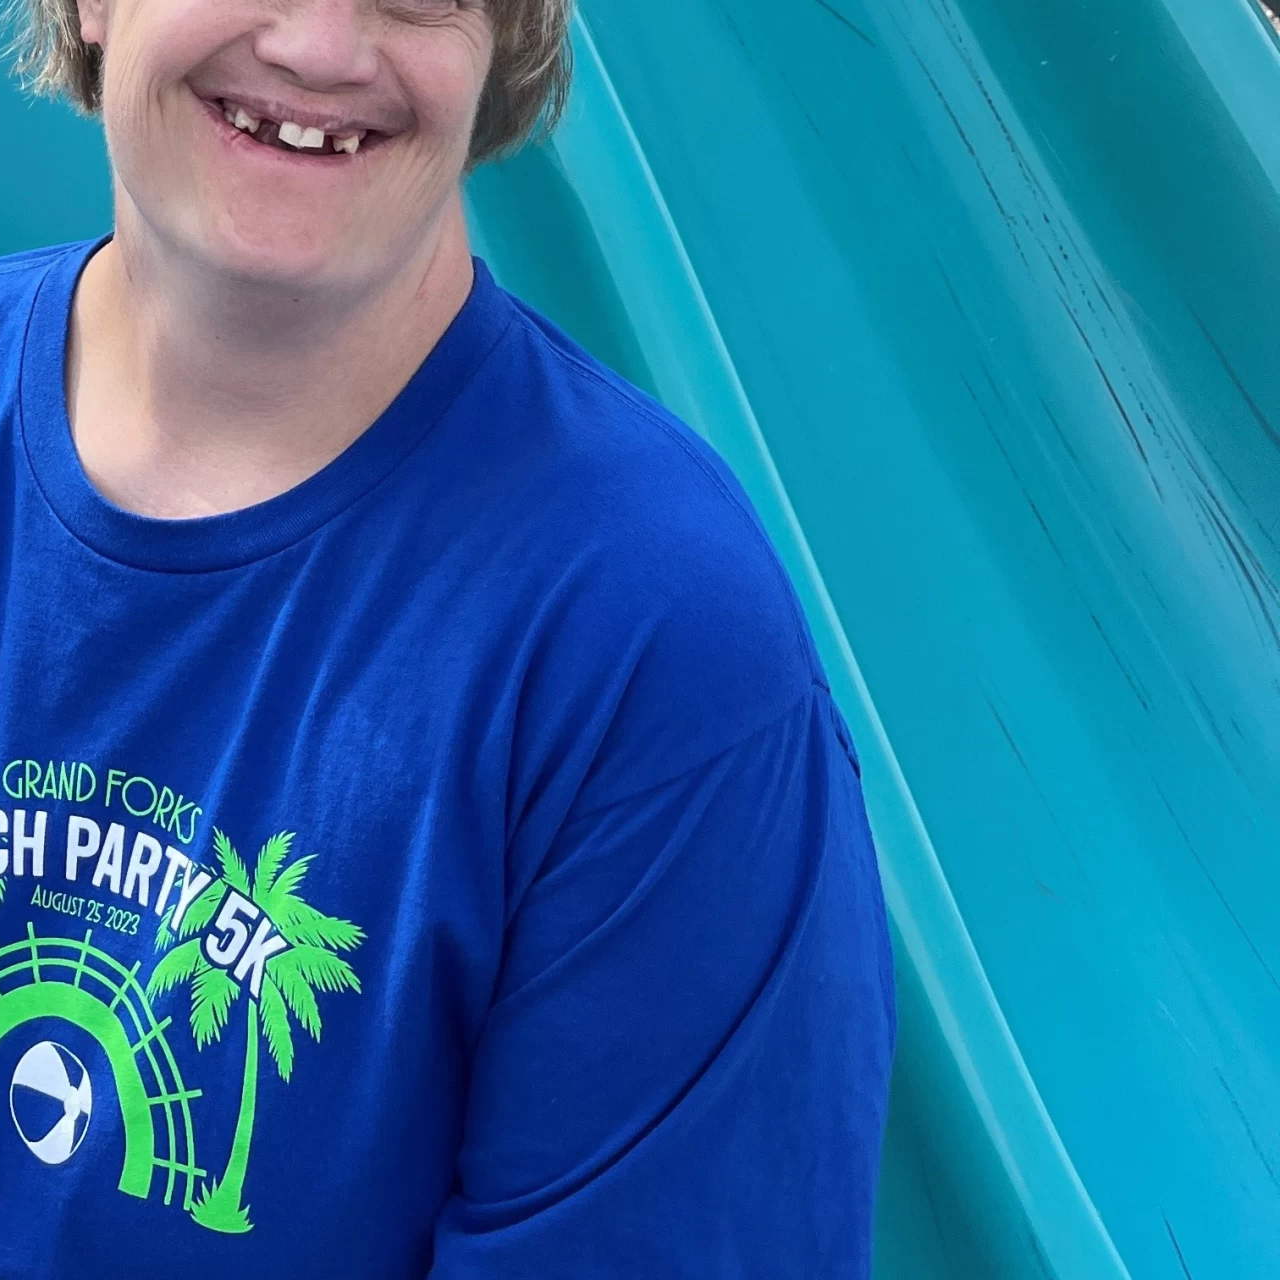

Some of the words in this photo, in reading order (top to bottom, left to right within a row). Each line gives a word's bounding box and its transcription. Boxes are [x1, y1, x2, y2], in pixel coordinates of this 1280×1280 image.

[2, 760, 96, 802] GRAND
[105, 769, 203, 844] FORKS
[30, 884, 86, 917] AUGUST
[104, 906, 141, 935] 2023
[66, 815, 212, 931] PARTY
[205, 894, 289, 998] 5K
